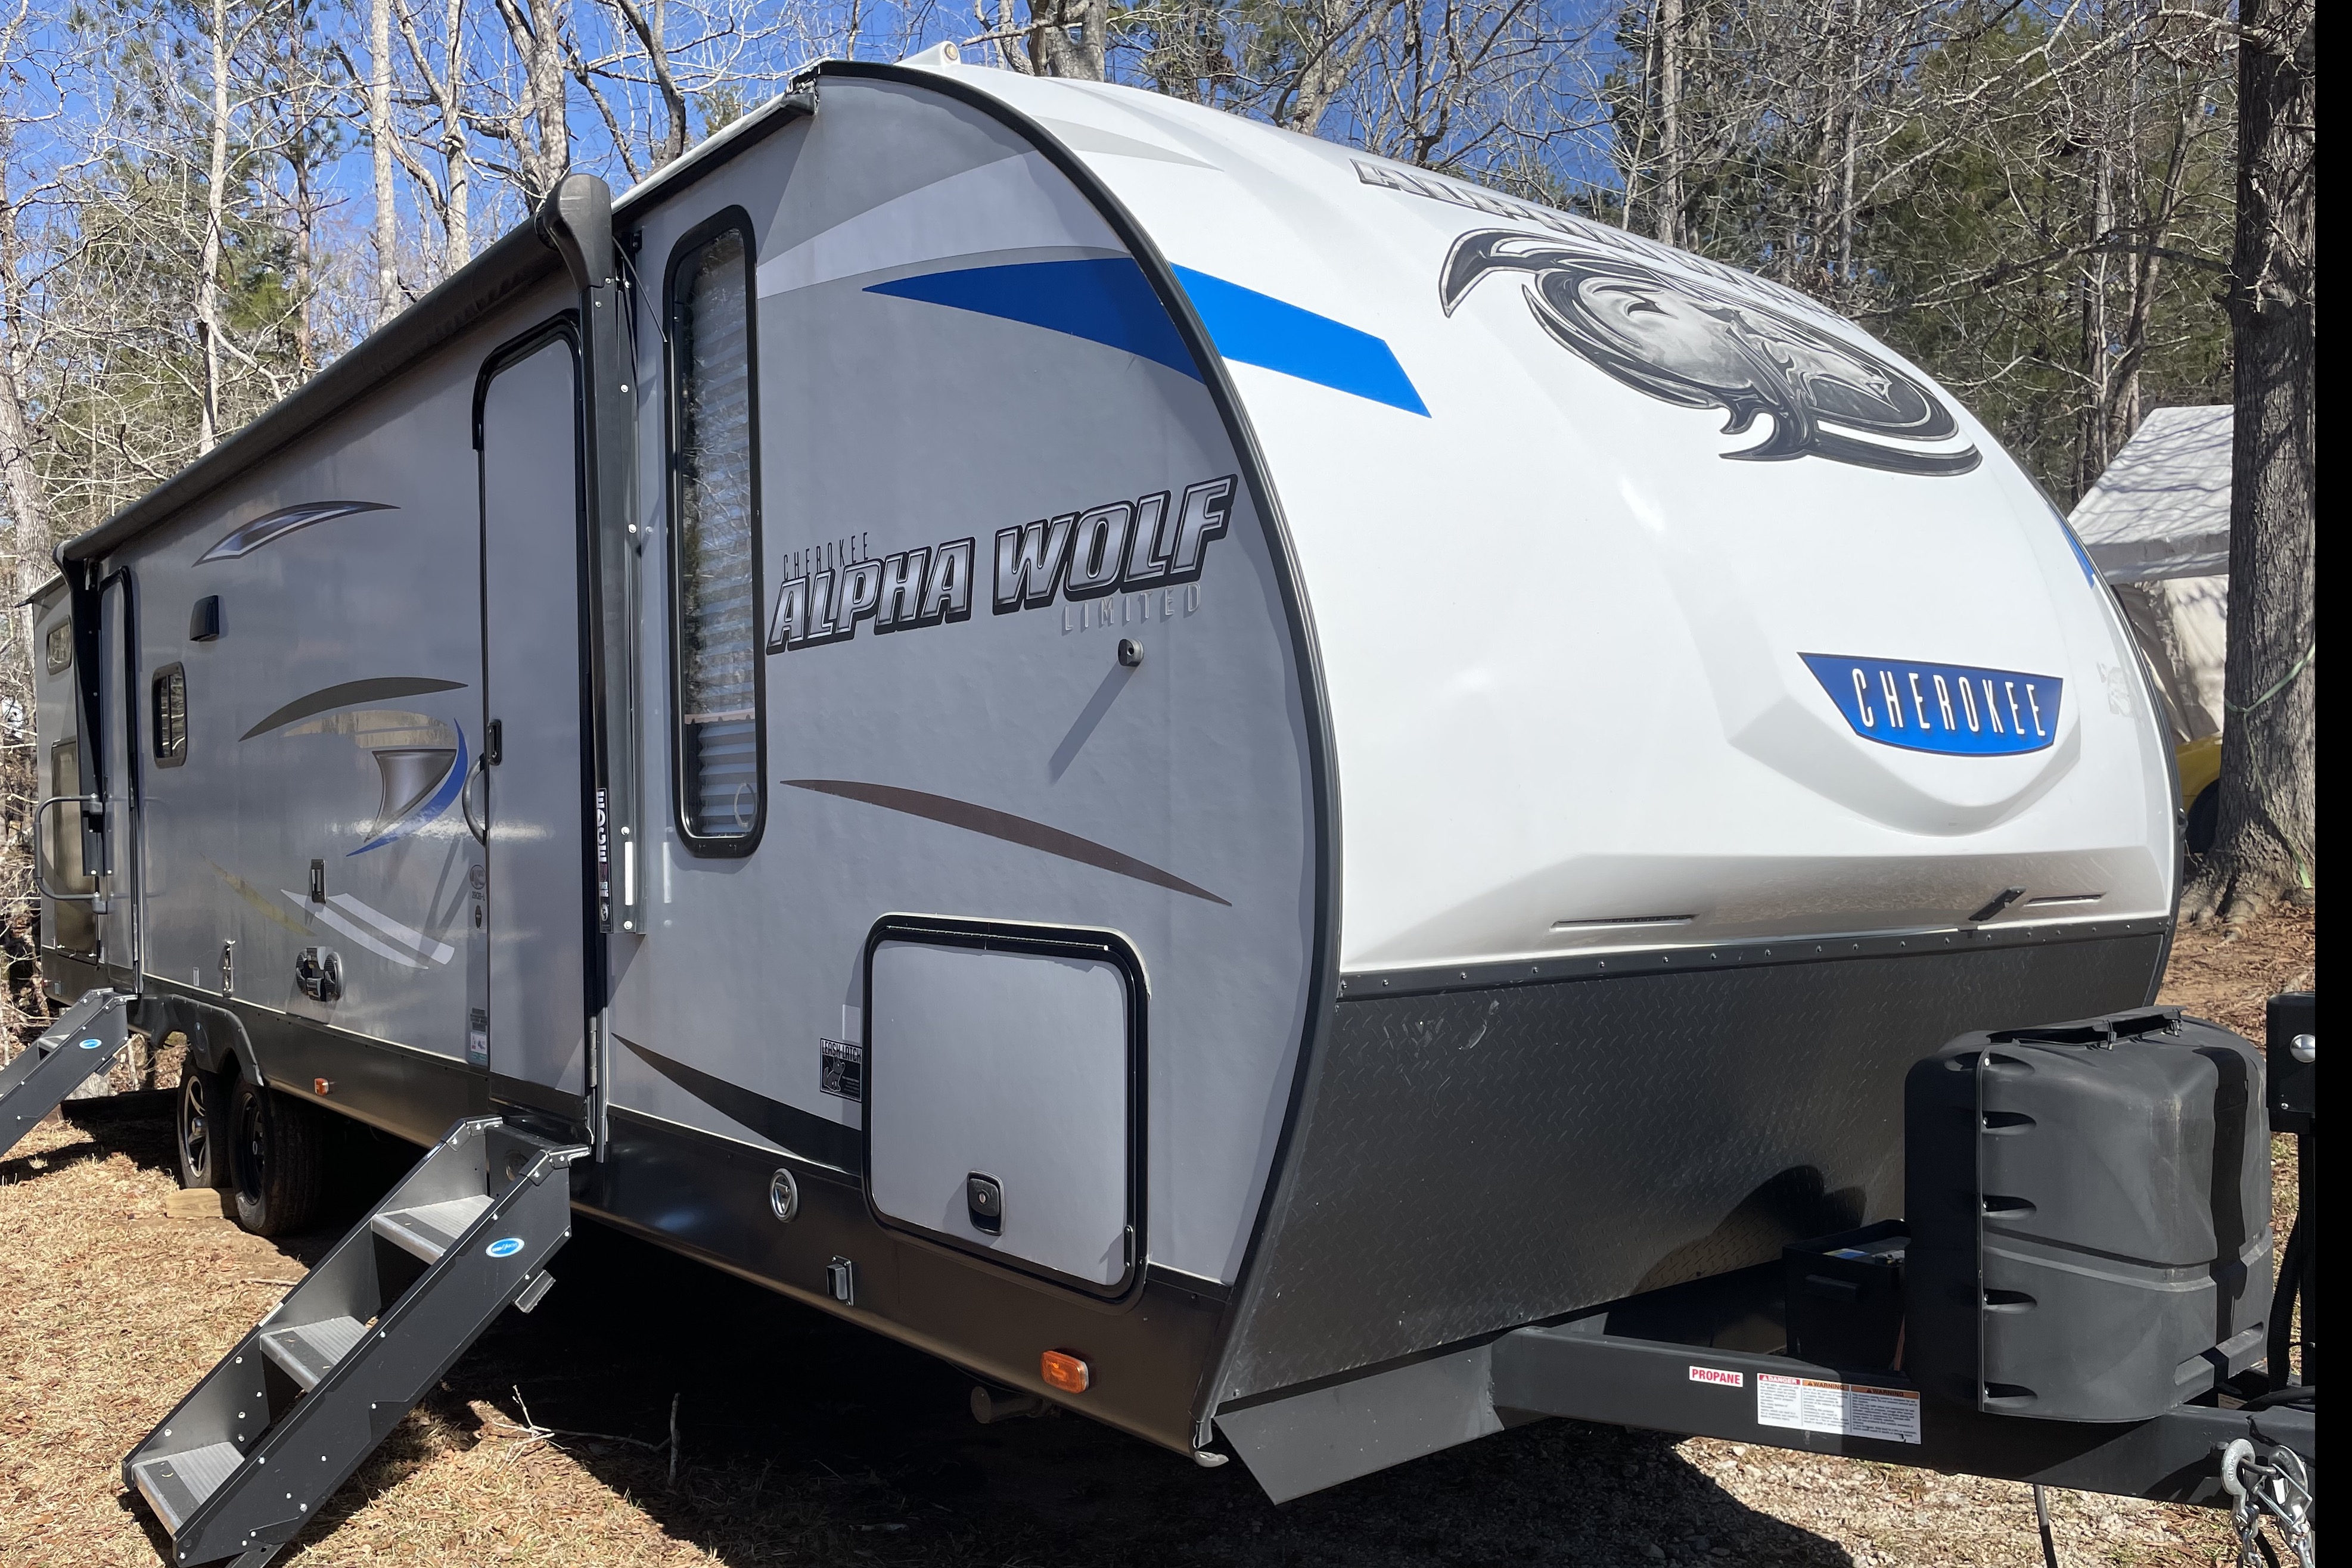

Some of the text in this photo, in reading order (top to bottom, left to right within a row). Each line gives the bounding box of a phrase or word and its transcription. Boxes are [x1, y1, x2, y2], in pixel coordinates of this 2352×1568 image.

[1349, 158, 1668, 263] ALPHA
[766, 474, 1238, 655] ALPHA WOLF
[783, 531, 869, 581] CHEROKEE
[1063, 581, 1201, 633] LIMITED
[1851, 668, 2046, 737] CHEROKEE
[1691, 1368, 1741, 1385] PROPANE
[1768, 1376, 1797, 1385] DANGER
[1813, 1382, 1844, 1390] WARNING
[1872, 1388, 1904, 1397] WARNING
